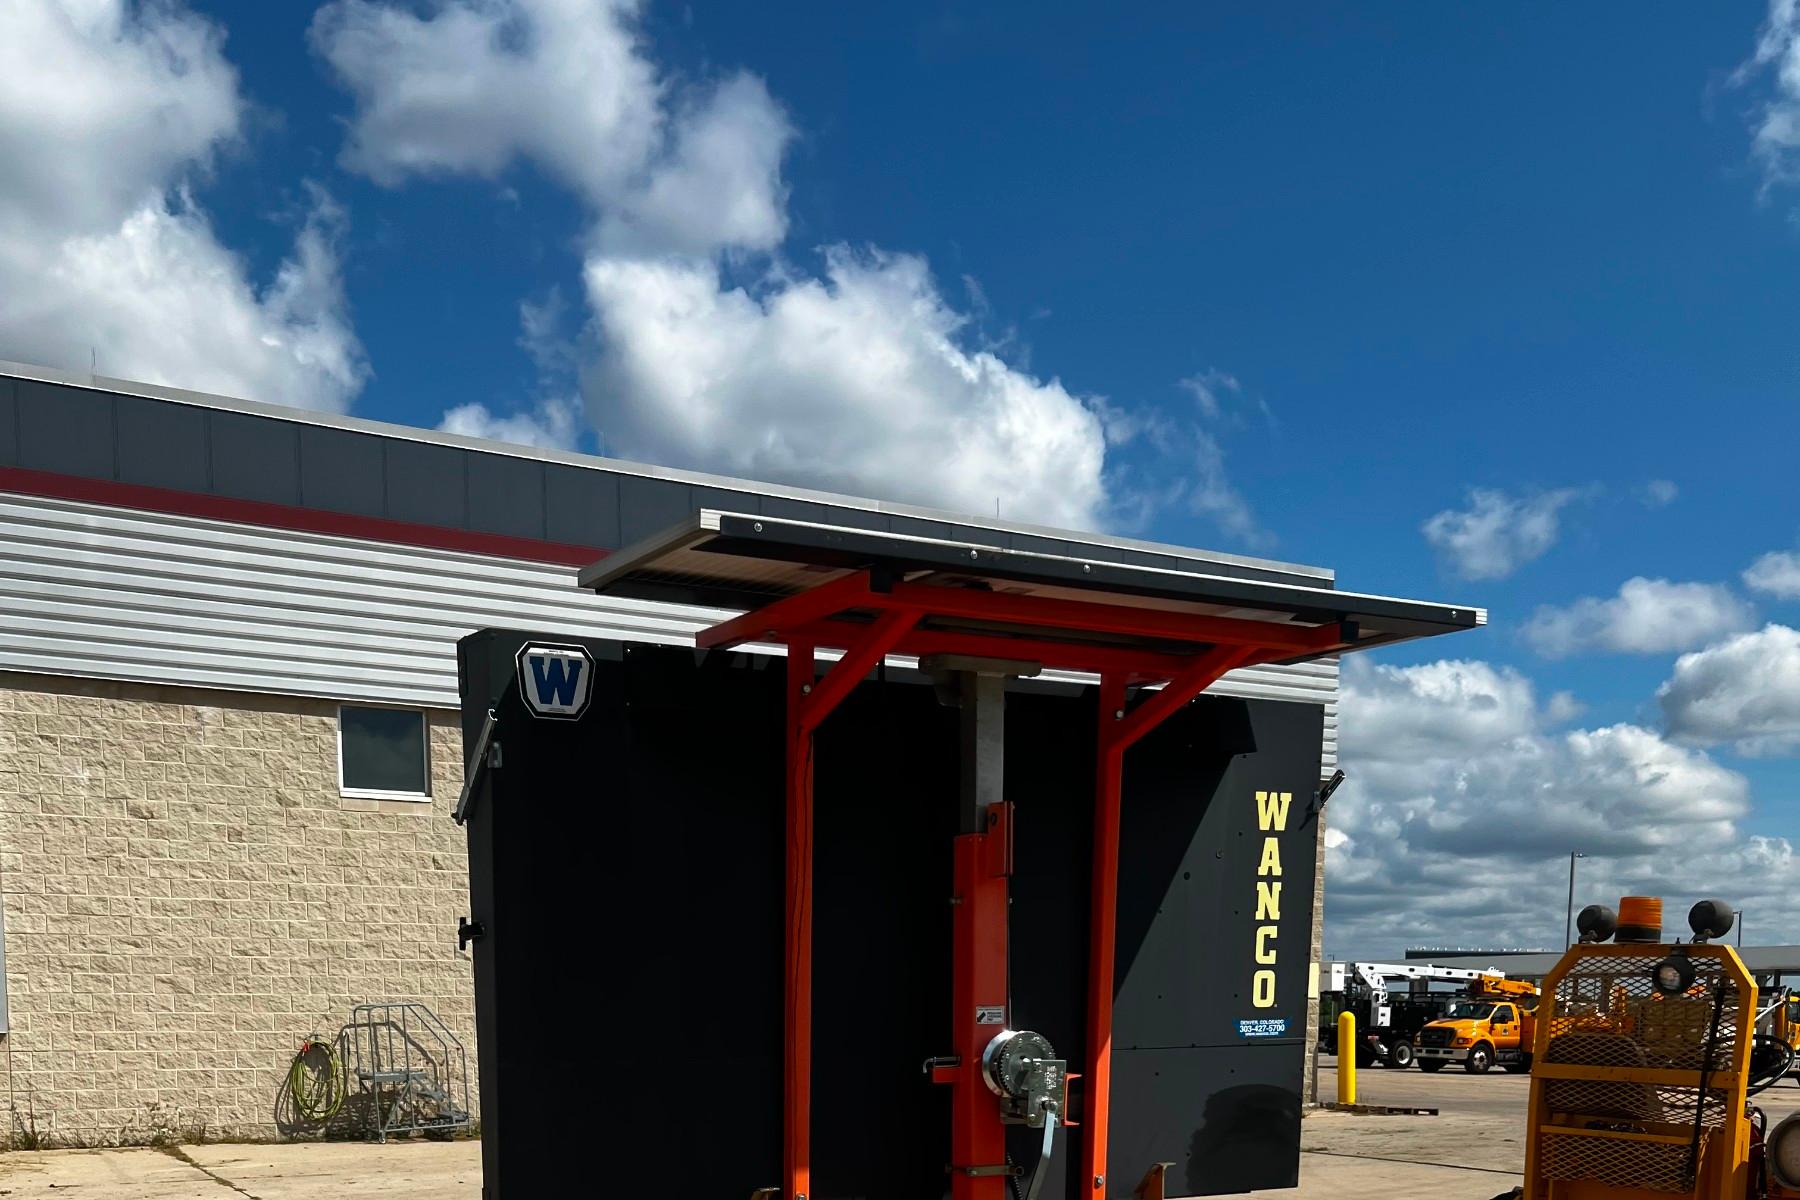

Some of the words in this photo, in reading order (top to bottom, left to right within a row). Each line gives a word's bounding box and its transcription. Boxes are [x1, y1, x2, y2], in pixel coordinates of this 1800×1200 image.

[529, 655, 583, 707] W
[1252, 790, 1293, 1008] WANCO
[1239, 1024, 1286, 1033] 303-427-5700
